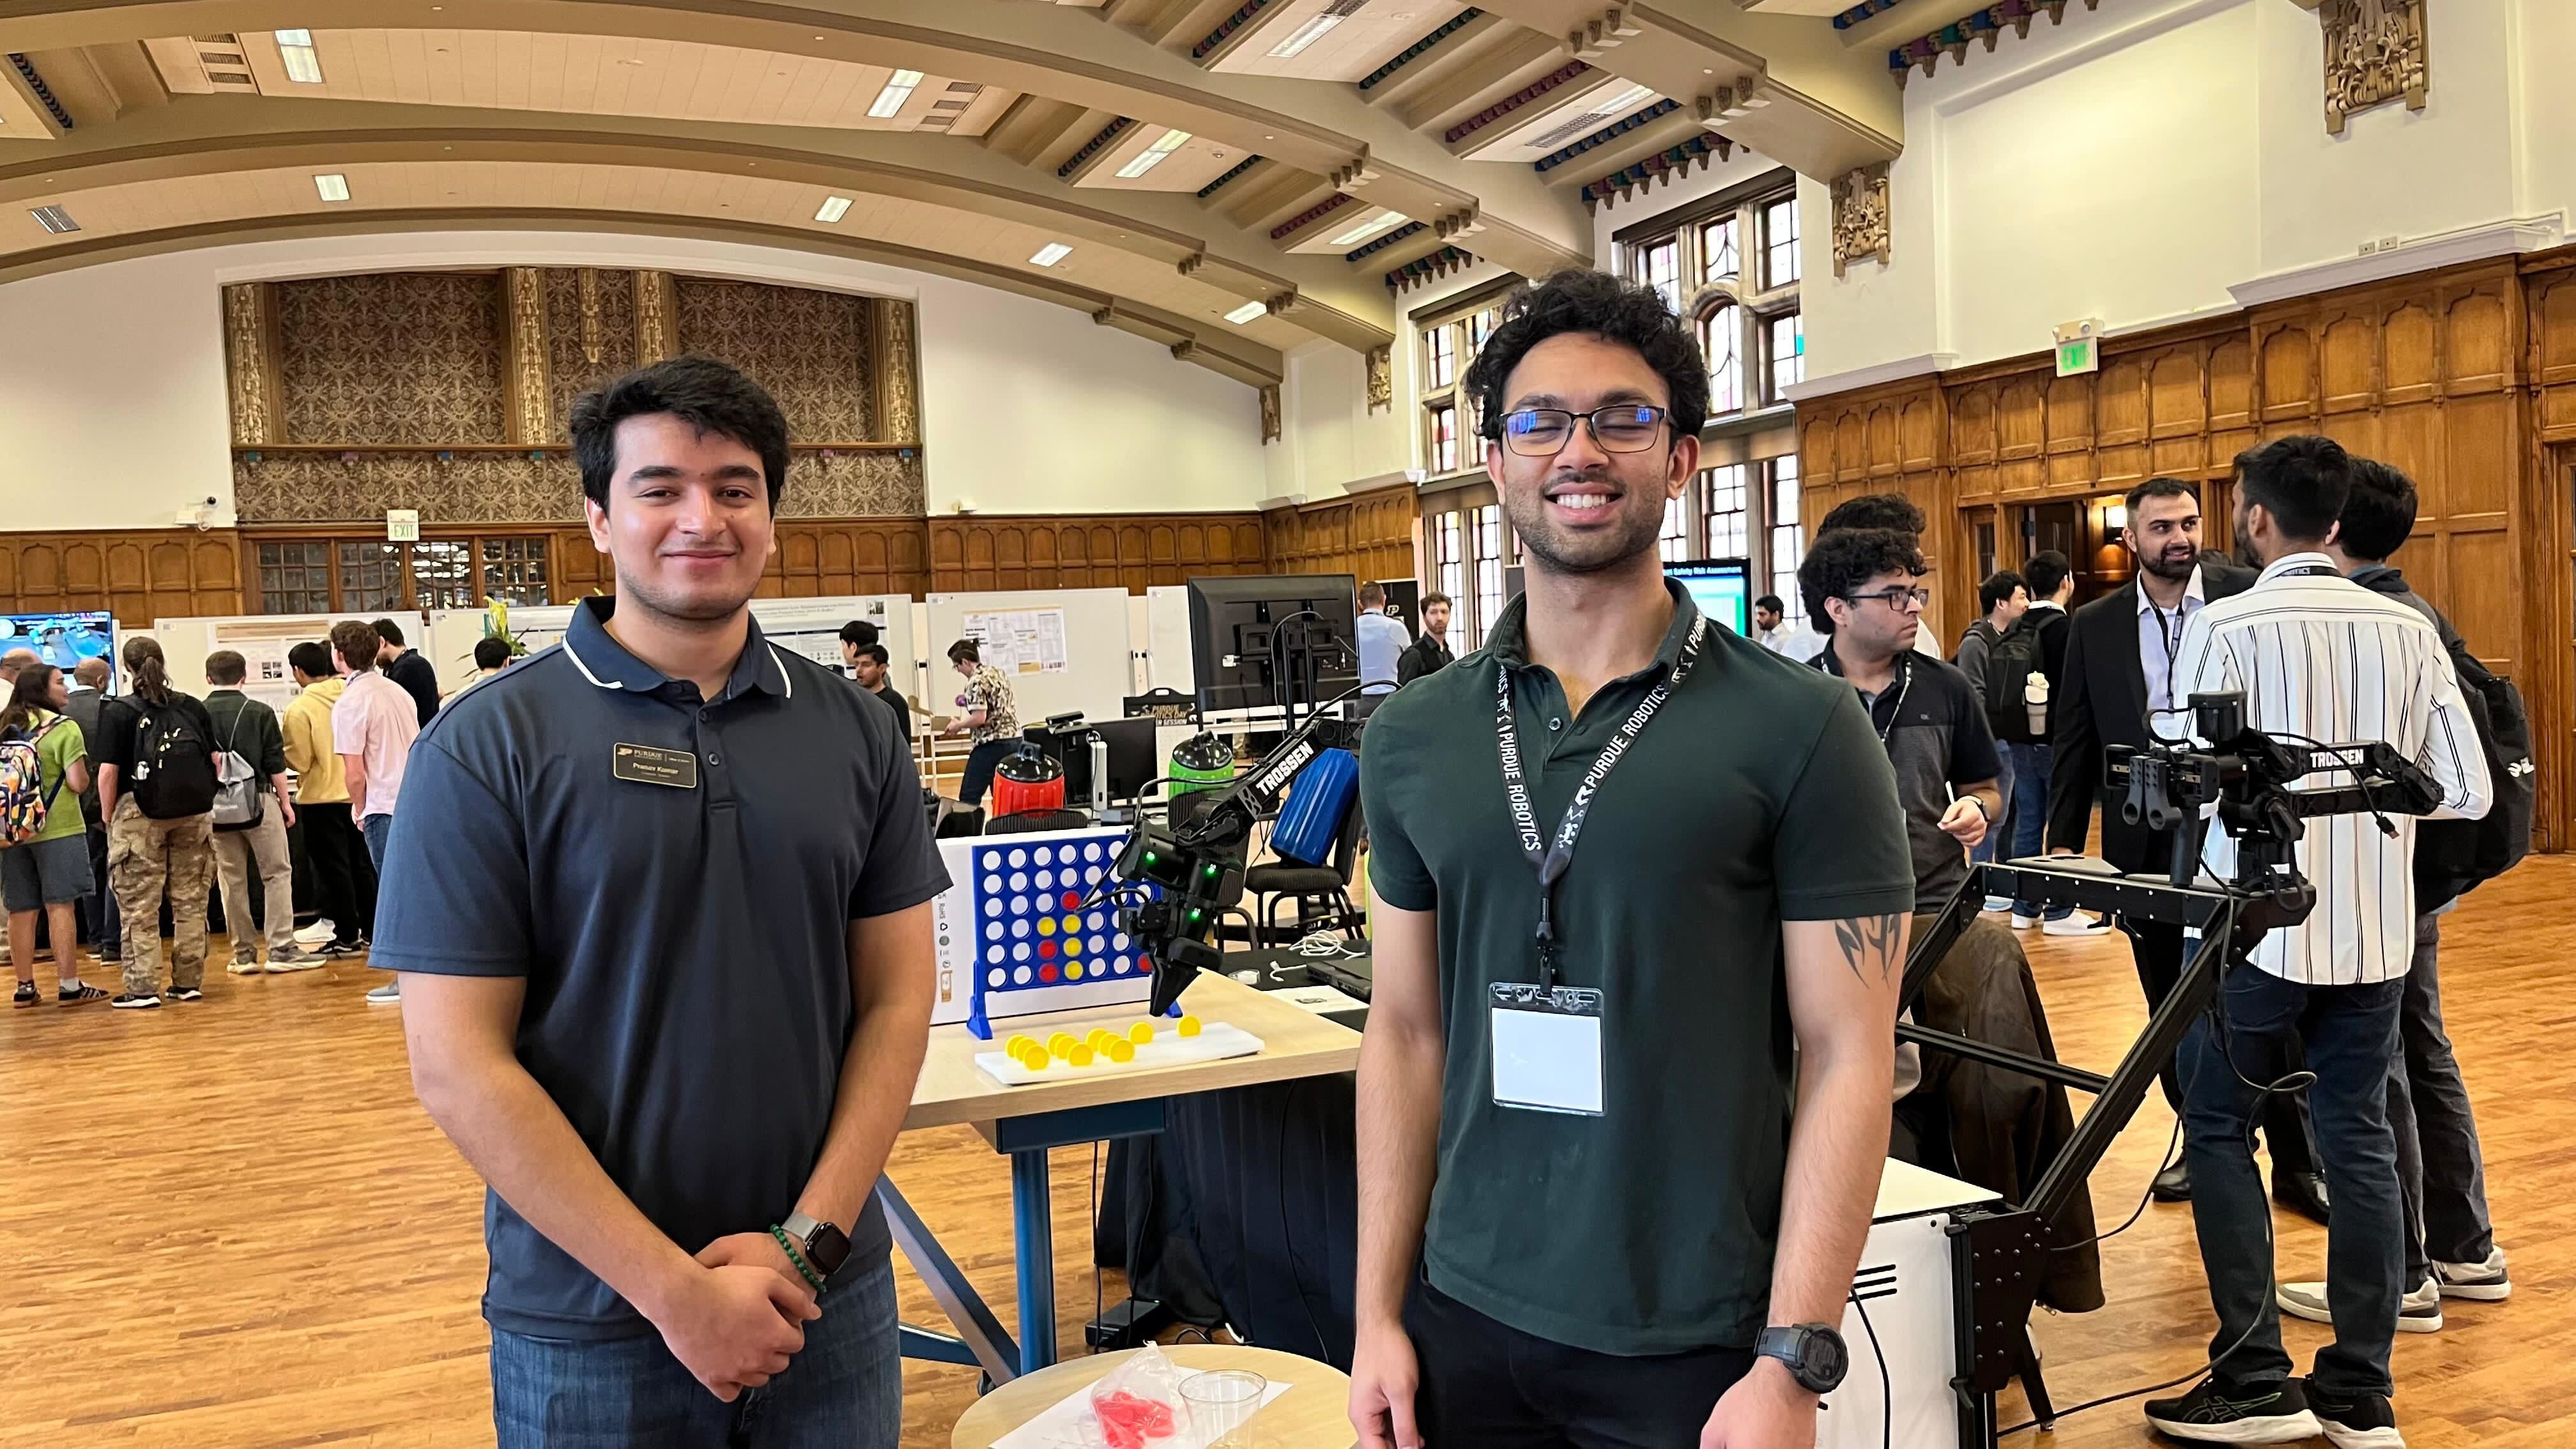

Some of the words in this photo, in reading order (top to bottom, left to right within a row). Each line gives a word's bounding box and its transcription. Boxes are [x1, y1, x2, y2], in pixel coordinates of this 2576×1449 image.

[394, 525, 413, 537] EXIT
[1499, 732, 1521, 780] PURDUE
[1584, 735, 1629, 788] PURDUE
[1621, 682, 1669, 737] ROBOTICS
[1255, 740, 1314, 796] TROSSEN
[1508, 785, 1542, 851] ROBOTICS
